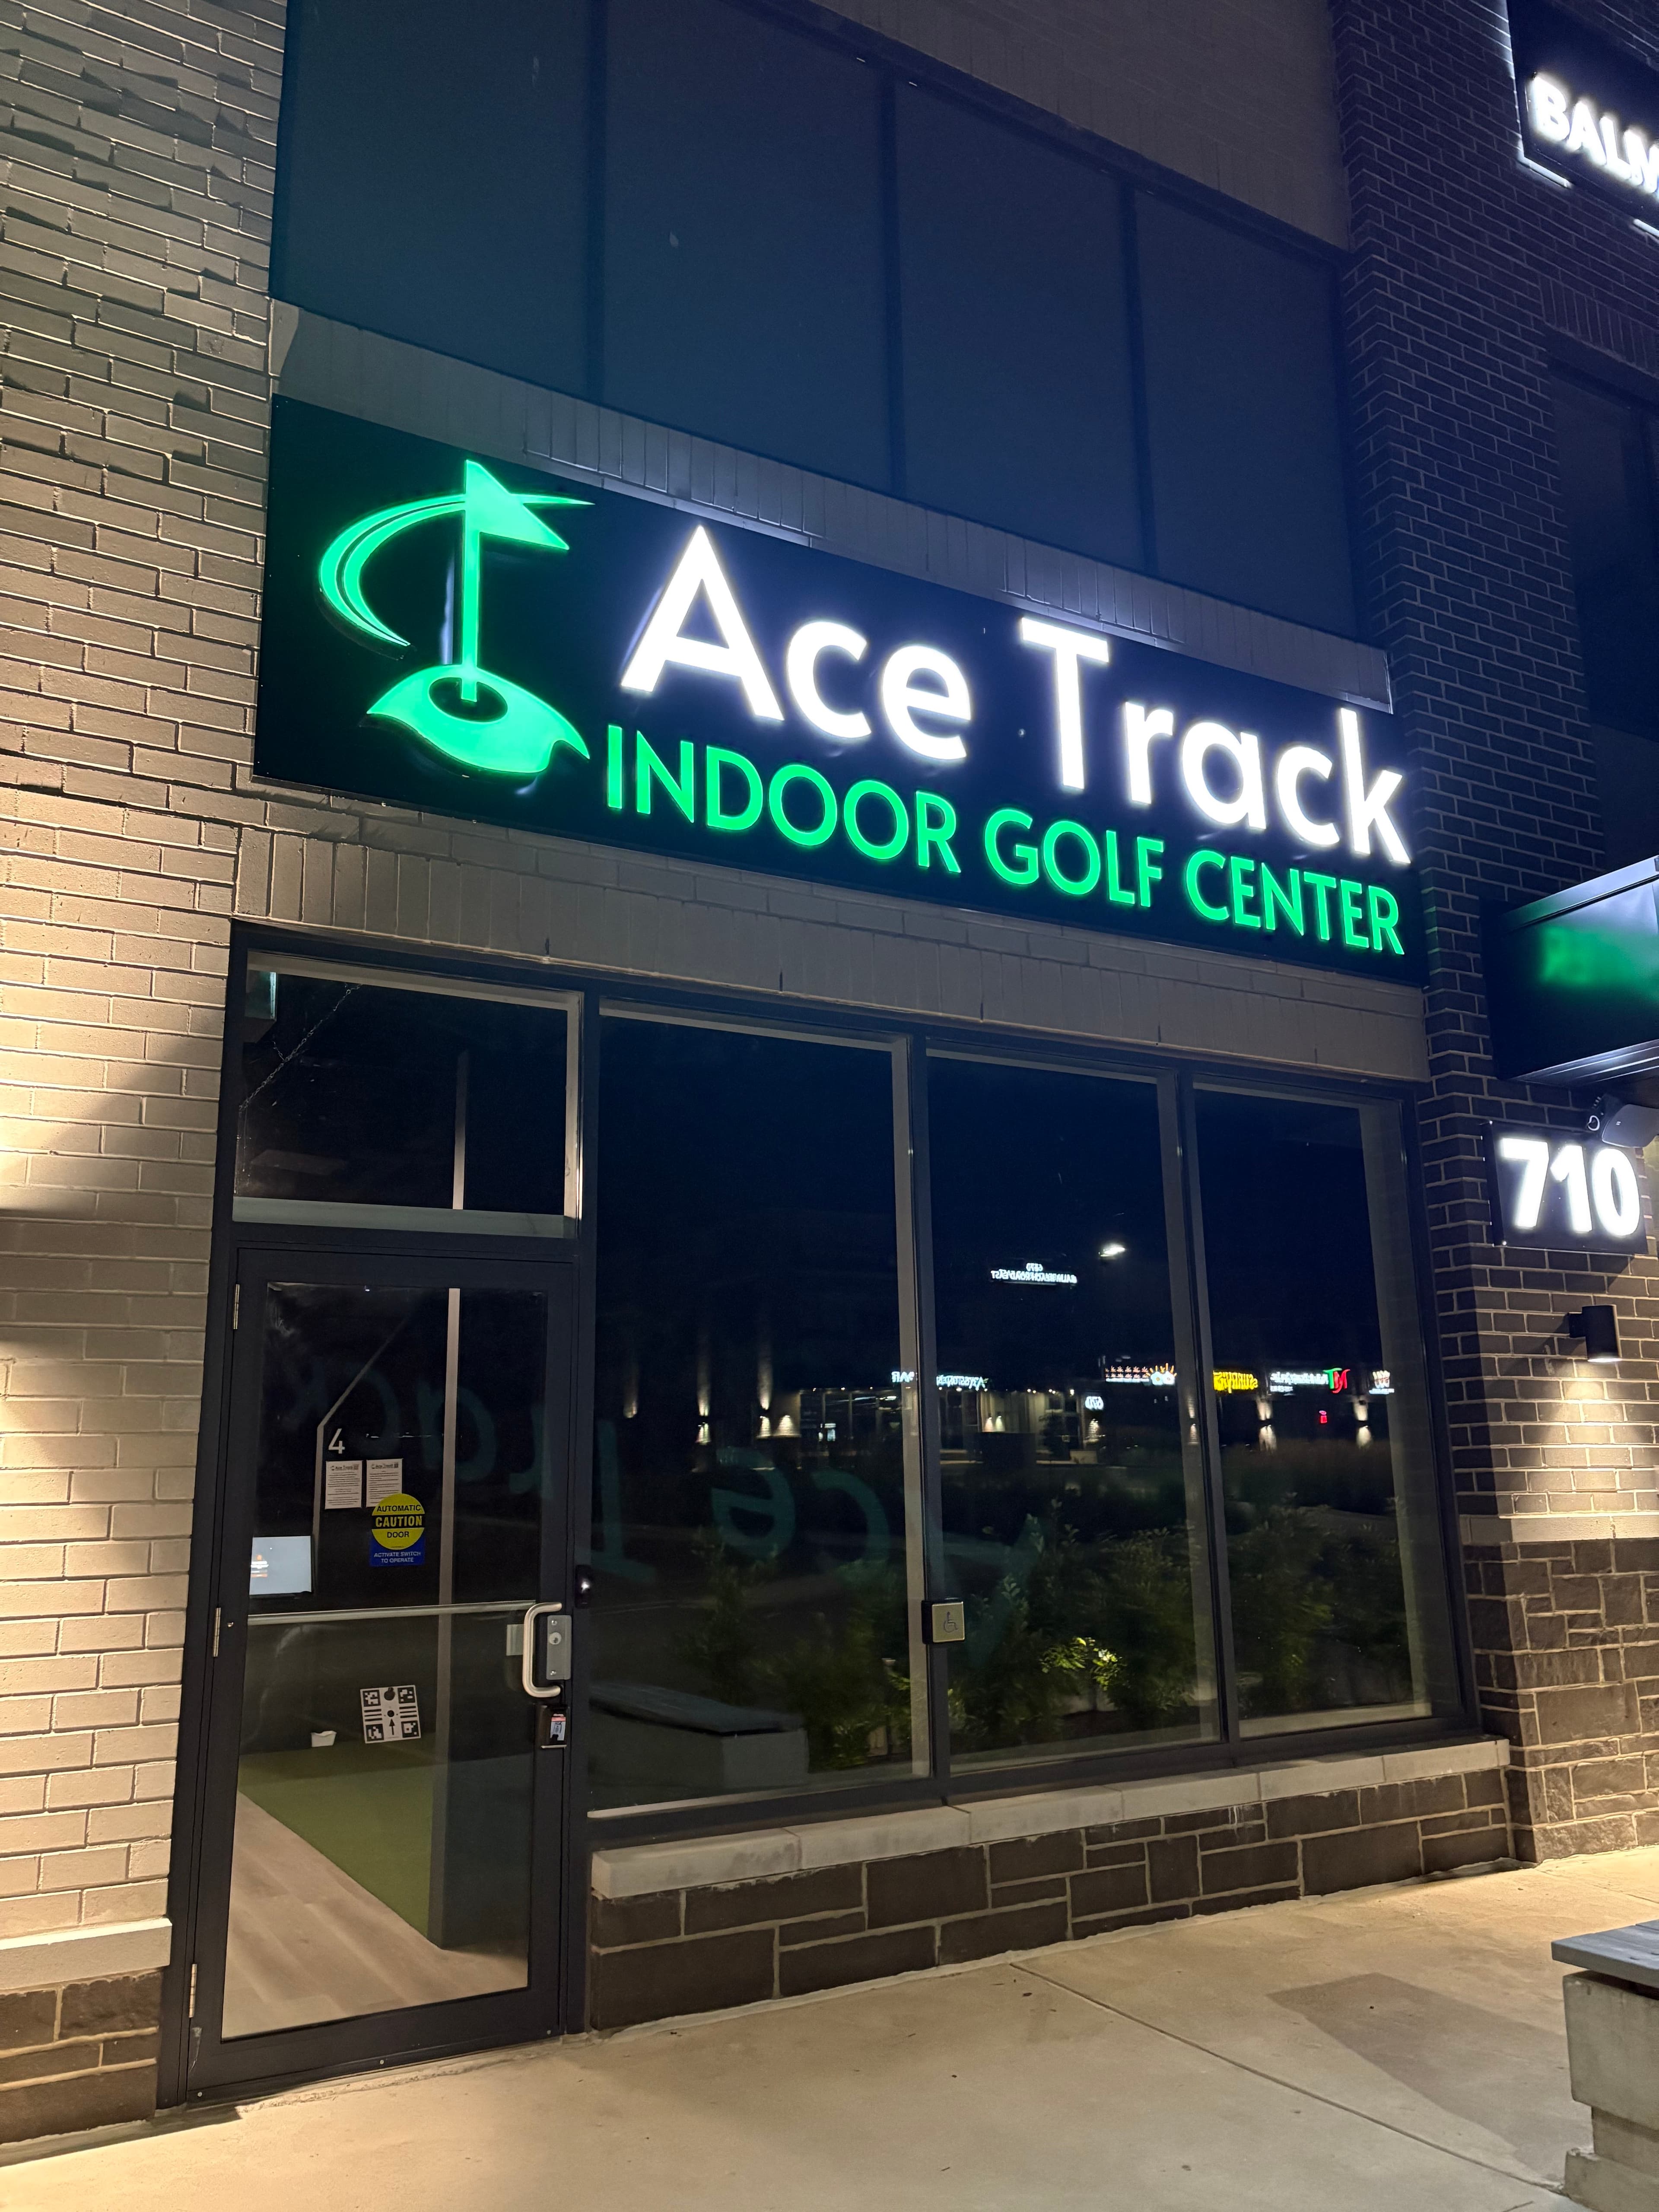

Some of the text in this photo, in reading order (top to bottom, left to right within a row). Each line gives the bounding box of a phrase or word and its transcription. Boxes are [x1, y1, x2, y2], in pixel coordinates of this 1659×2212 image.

[620, 525, 1412, 864] Ace Track
[606, 724, 1404, 956] INDOOR GOLF CENTER
[1500, 1137, 1641, 1237] 710
[328, 1428, 345, 1454] 4
[375, 1516, 422, 1527] CAUTION
